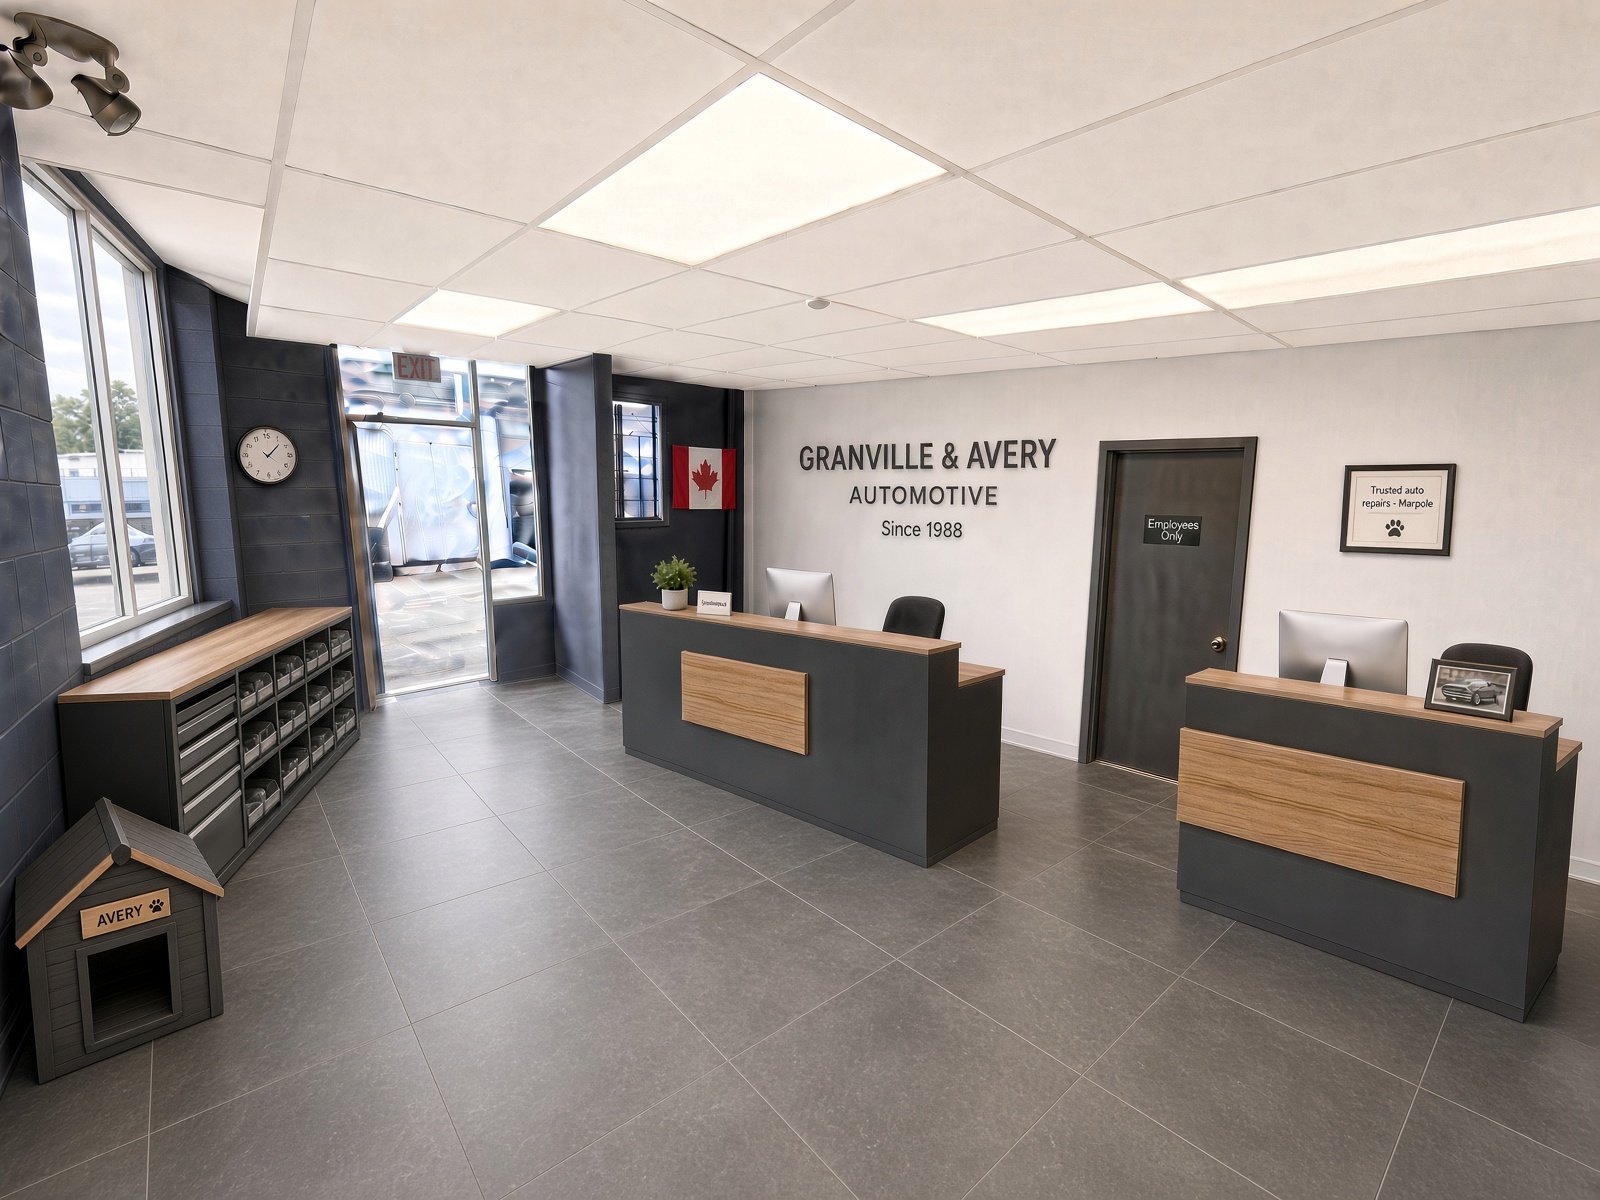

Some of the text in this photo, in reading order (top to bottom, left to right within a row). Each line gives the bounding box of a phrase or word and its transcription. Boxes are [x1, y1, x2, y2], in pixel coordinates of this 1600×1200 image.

[398, 355, 435, 380] EXIT
[799, 438, 1057, 471] GRANVILLE & AVERY
[849, 485, 998, 506] AUTOMOTIVE
[1371, 485, 1424, 495] Trusted auto
[1362, 499, 1391, 509] repairs
[1398, 499, 1433, 510] Marpole
[881, 520, 963, 538] Since 1988
[1148, 518, 1199, 531] Employees
[1161, 530, 1183, 544] Only
[97, 904, 143, 927] AVERY
